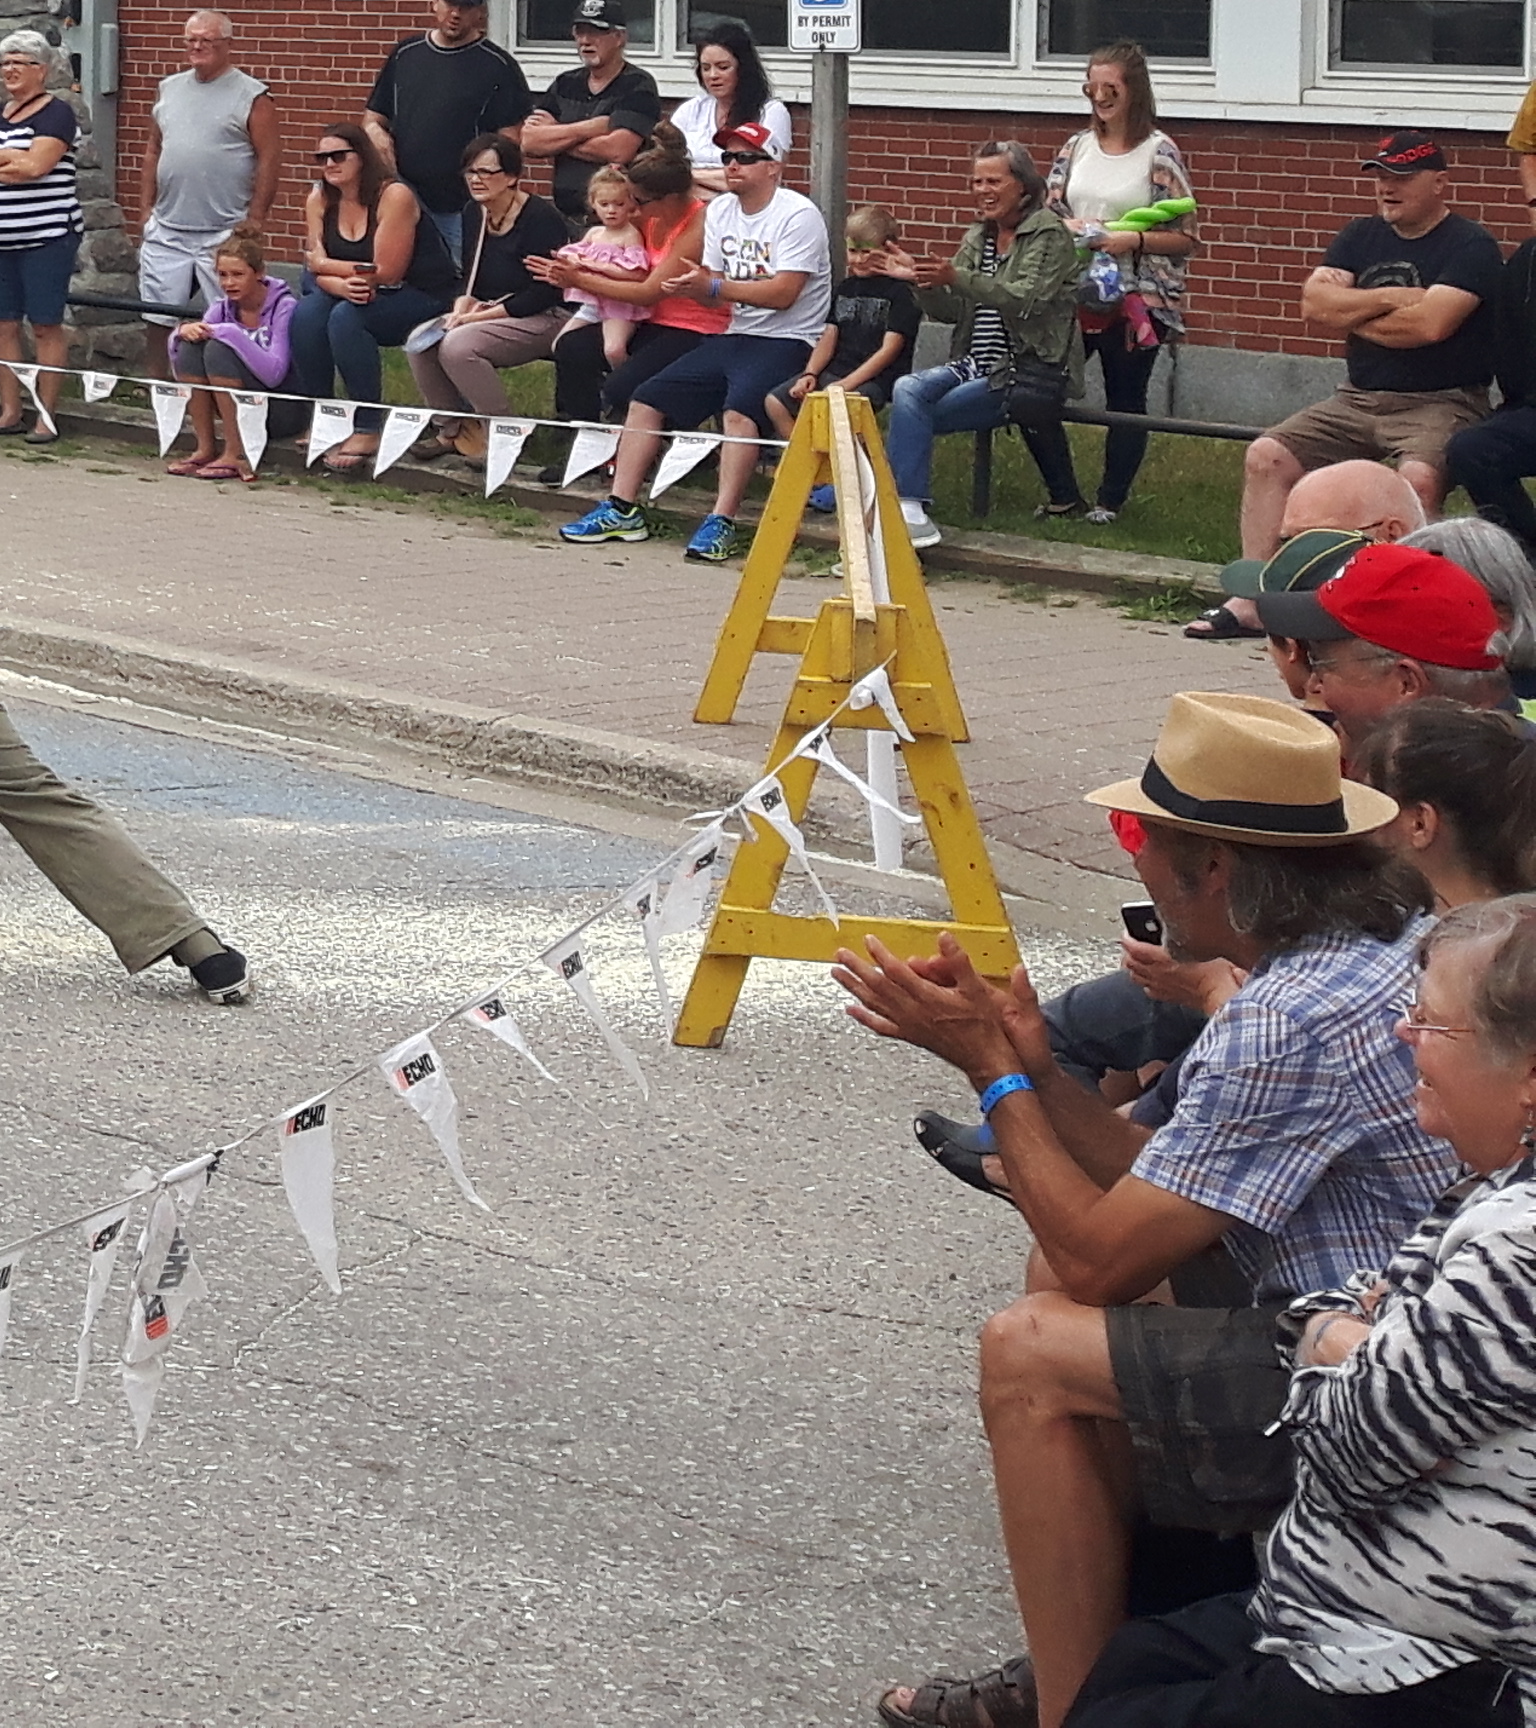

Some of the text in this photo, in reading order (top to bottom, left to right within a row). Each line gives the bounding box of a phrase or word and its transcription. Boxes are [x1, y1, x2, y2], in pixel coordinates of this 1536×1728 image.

[798, 16, 851, 27] BY PERMIT
[812, 32, 836, 43] ONLY
[402, 1053, 436, 1086] ECHO
[293, 1103, 326, 1133] ECHO
